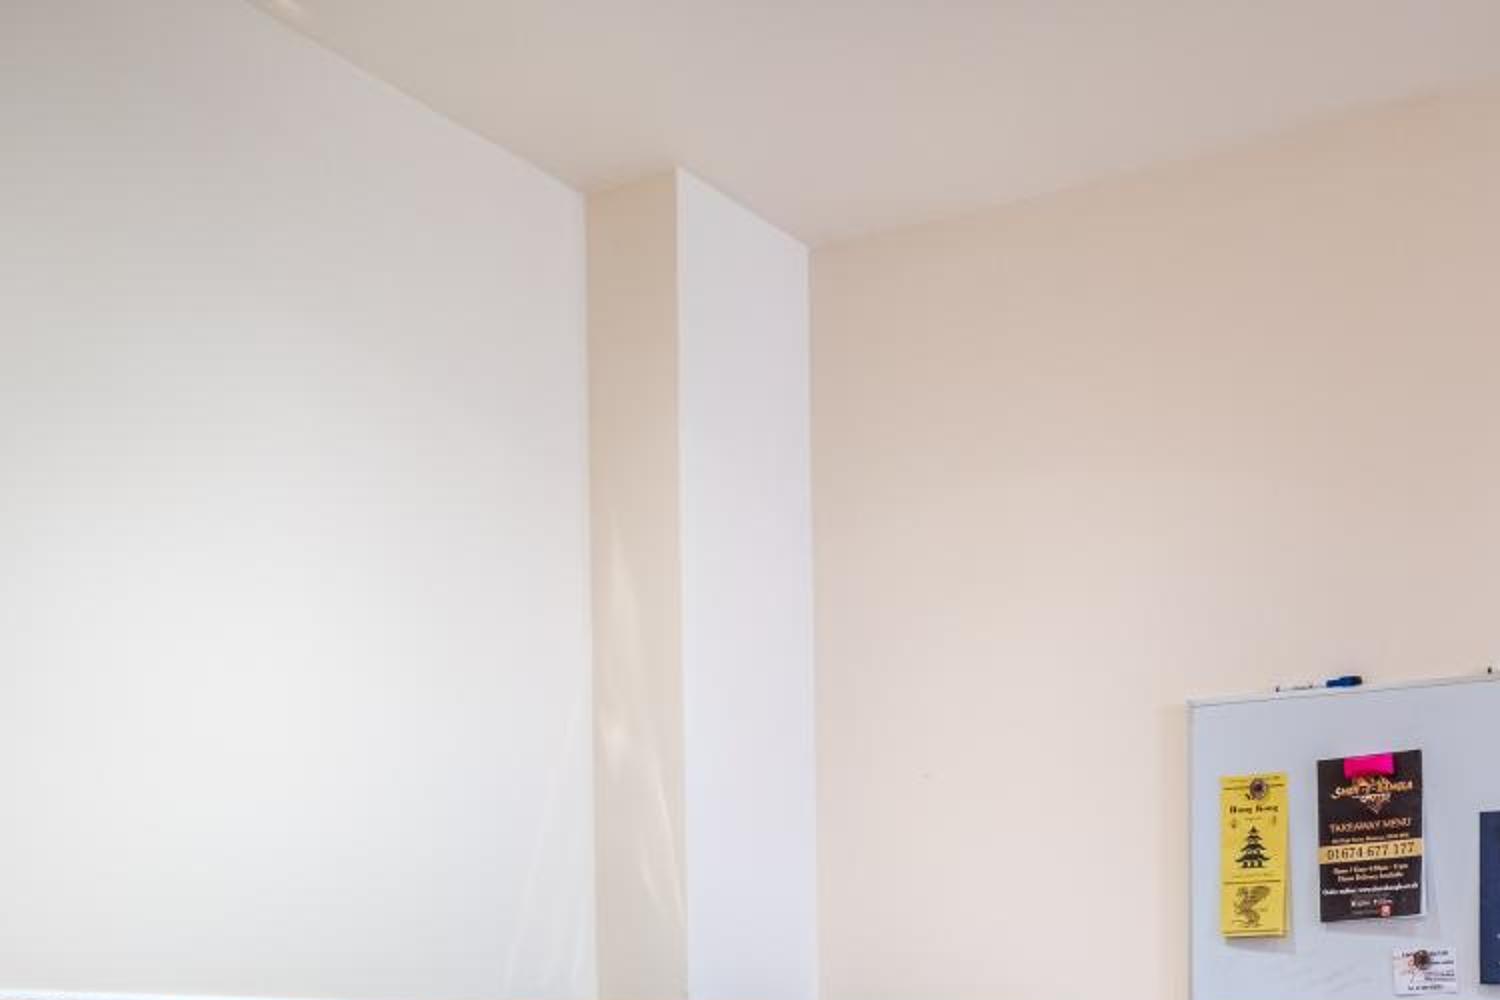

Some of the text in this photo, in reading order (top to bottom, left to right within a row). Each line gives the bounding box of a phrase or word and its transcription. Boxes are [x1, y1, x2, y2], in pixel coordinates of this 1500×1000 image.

[1330, 816, 1411, 833] TAKEAWAY MENU
[1327, 840, 1415, 860] 01674 677 177
